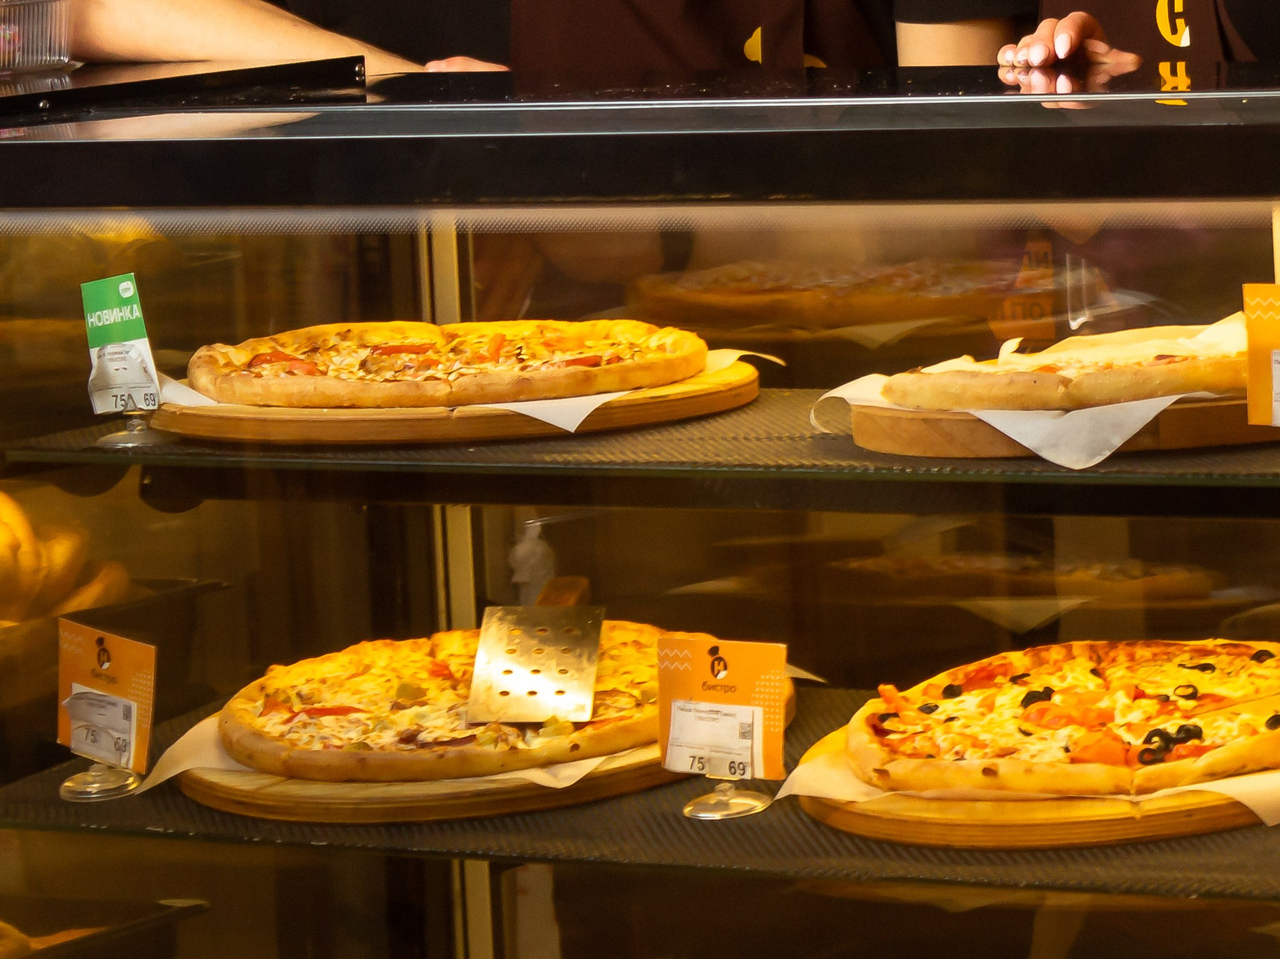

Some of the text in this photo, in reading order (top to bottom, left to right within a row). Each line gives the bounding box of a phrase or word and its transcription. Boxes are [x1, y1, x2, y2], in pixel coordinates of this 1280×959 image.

[87, 304, 141, 328] НОВИНКА
[702, 681, 737, 694] бистро
[688, 755, 706, 771] 75
[728, 760, 746, 776] 69
